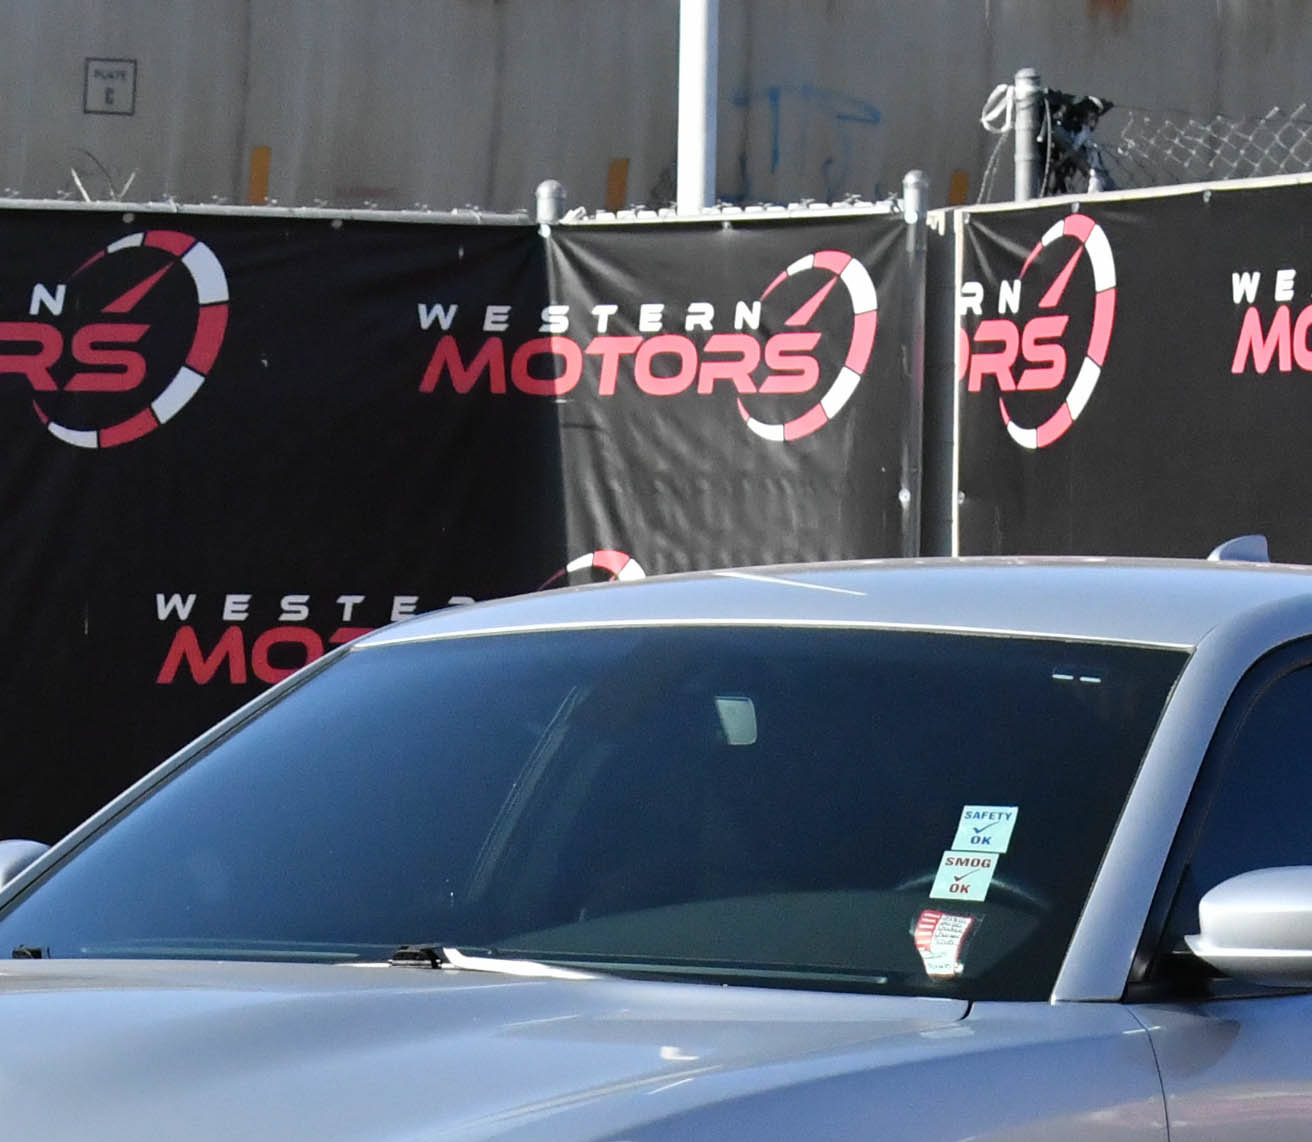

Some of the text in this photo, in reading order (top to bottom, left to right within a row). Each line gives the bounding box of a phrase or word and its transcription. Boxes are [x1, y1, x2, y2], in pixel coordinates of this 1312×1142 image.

[417, 301, 761, 332] WESTERN
[959, 315, 1069, 392] RS
[419, 333, 823, 397] MOTORS
[155, 592, 476, 621] WESTE
[964, 811, 1013, 821] SAFETY
[970, 835, 992, 846] OK
[944, 856, 993, 869] SMOG
[949, 883, 972, 894] OK
